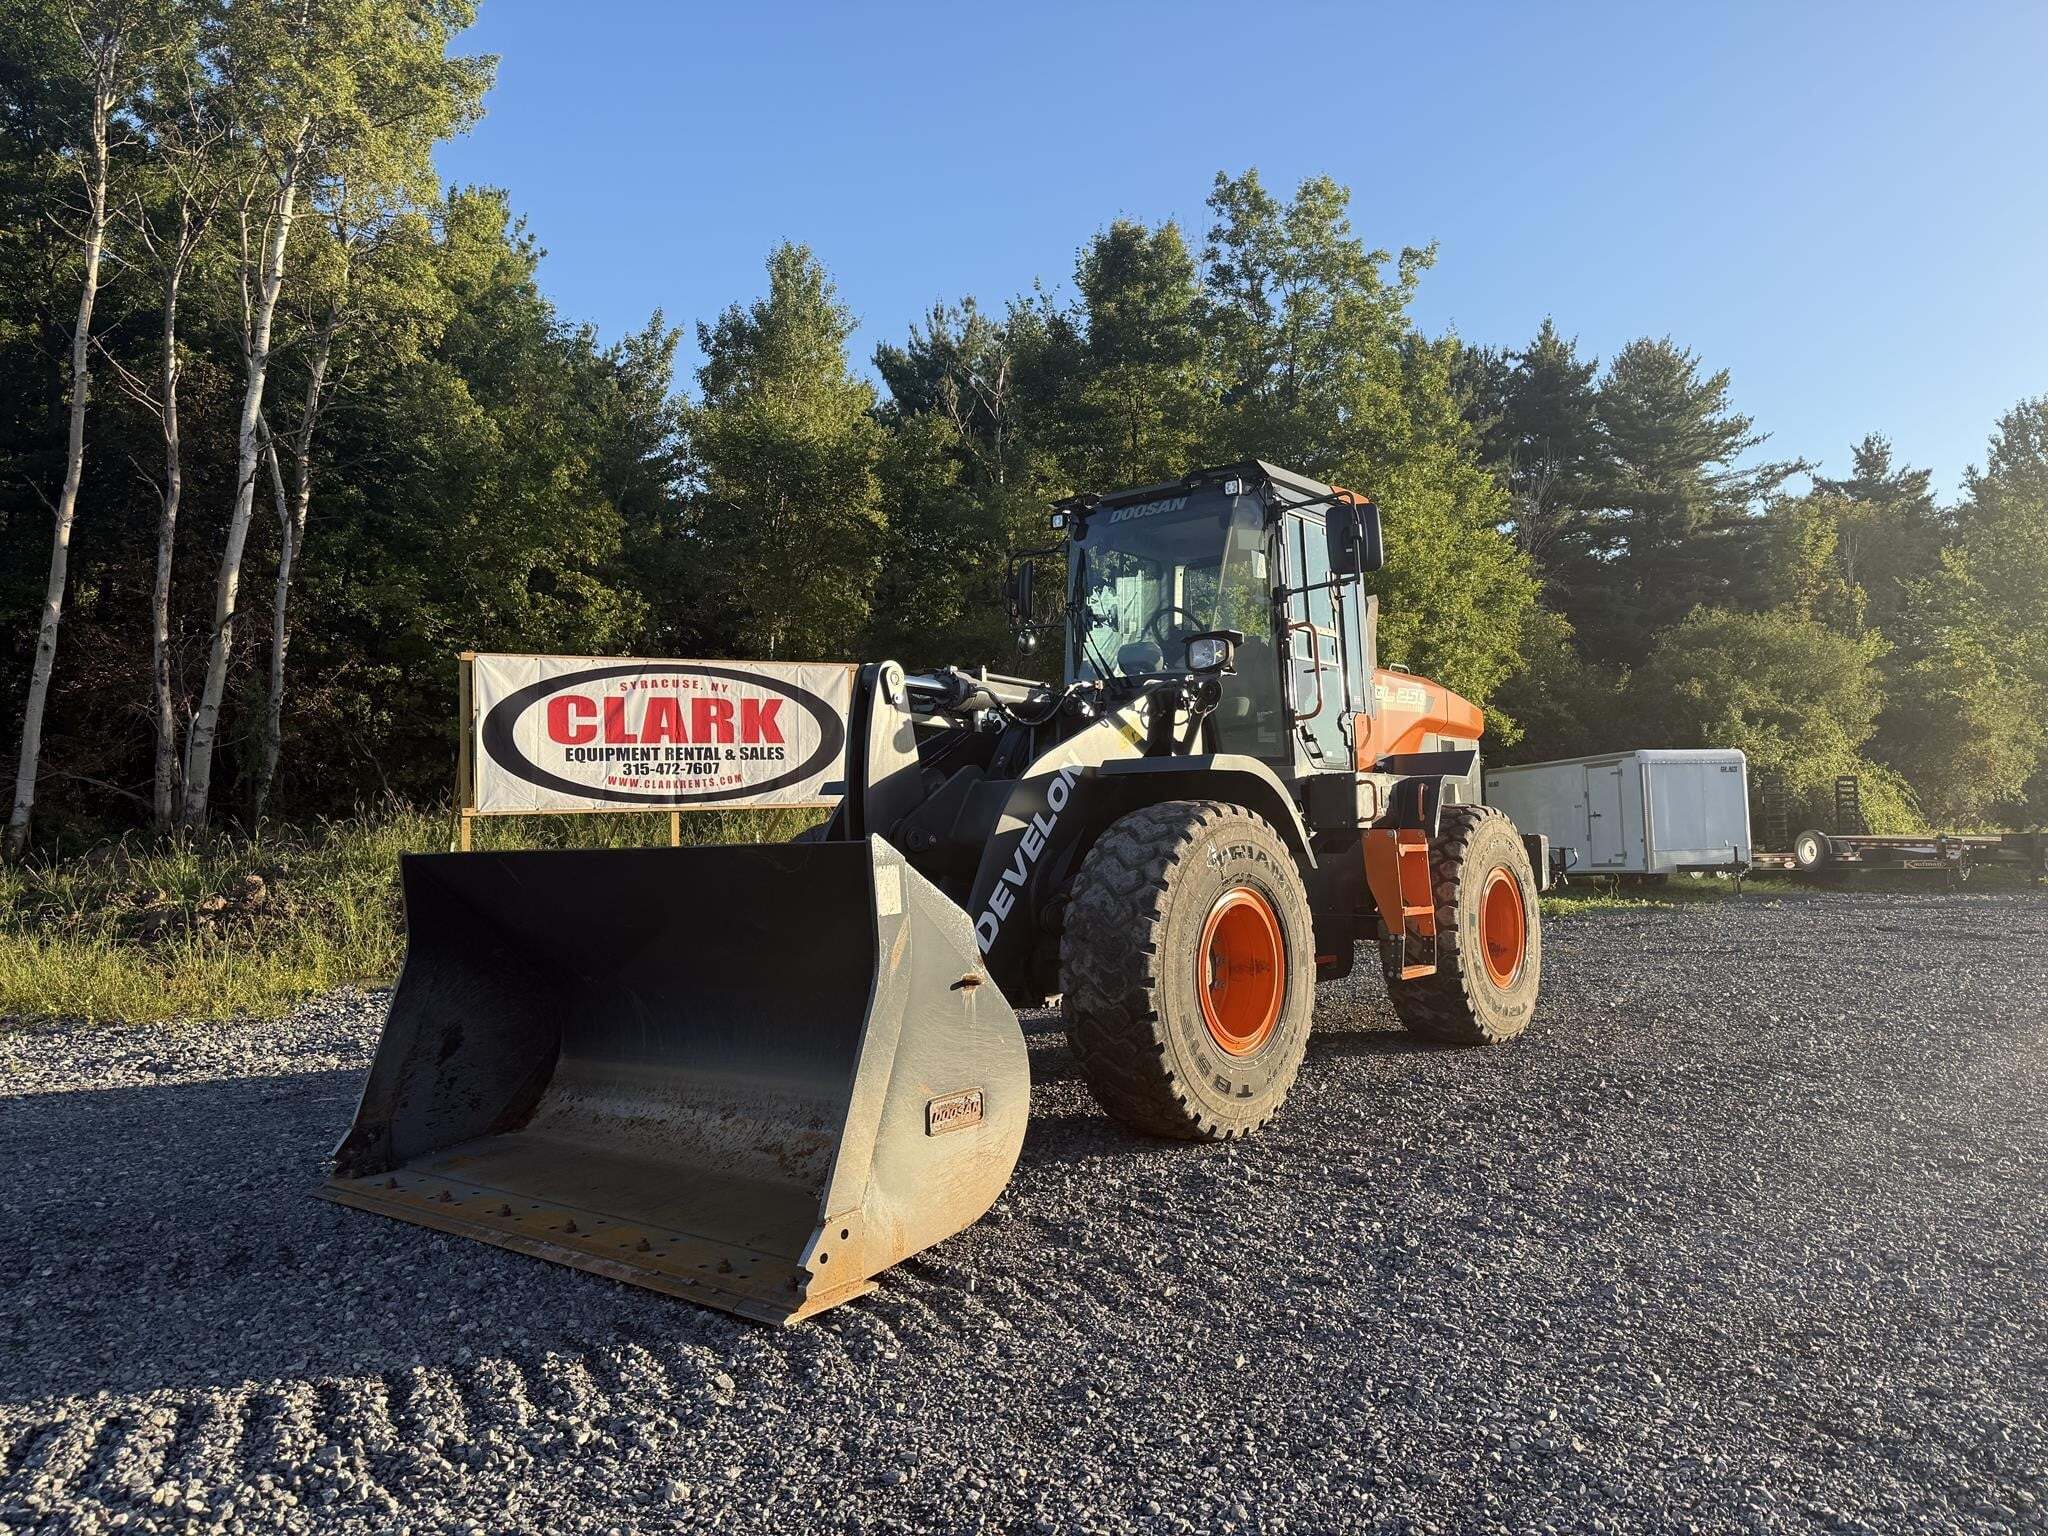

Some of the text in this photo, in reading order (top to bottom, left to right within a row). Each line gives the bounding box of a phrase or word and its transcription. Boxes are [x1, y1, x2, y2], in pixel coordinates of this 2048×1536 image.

[1109, 496, 1188, 523] DOOSAN
[711, 682, 728, 693] NY
[547, 694, 785, 745] CLARK
[565, 746, 785, 763] EQUIPMENT RENTAL & SALES
[622, 762, 720, 775] 315-472-7607
[607, 773, 743, 789] WWW.CLARKRENTS.COM
[975, 748, 1085, 955] DEVELON
